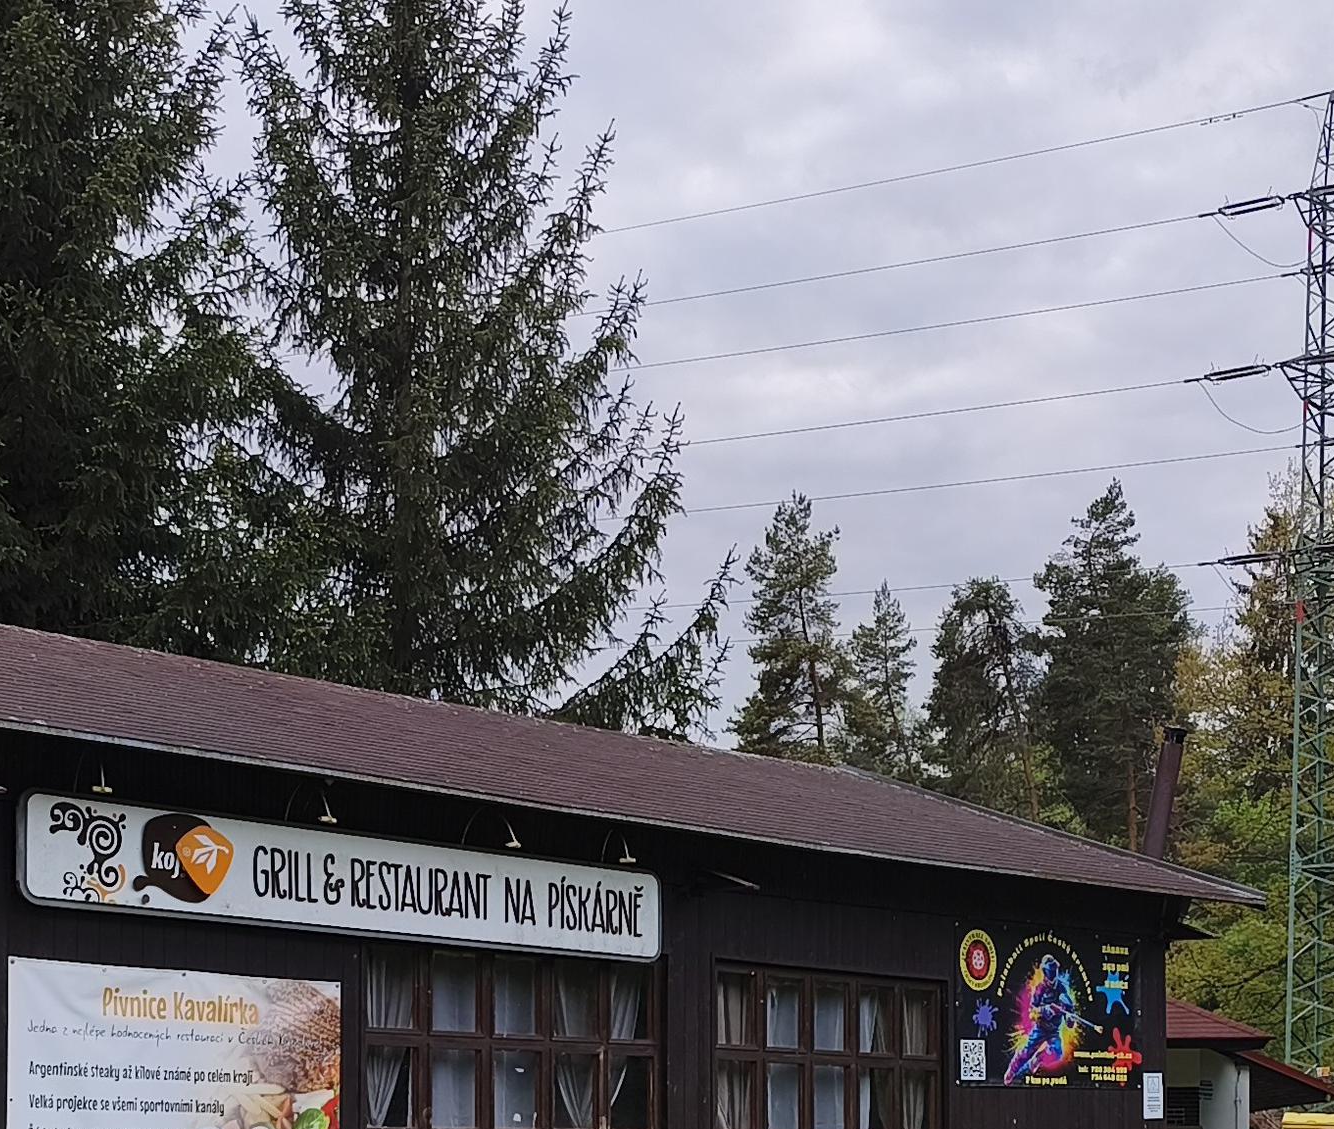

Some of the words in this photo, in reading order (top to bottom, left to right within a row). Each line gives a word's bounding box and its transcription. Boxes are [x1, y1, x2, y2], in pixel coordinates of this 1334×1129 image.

[253, 845, 319, 904] GRILL
[324, 852, 345, 906] &
[350, 859, 492, 921] RESTAURANT
[504, 878, 537, 926] NA
[548, 876, 644, 938] PÍSKÁRNĚ
[102, 986, 167, 1020] Pivnice
[173, 990, 260, 1025] Kavalírka
[72, 1021, 106, 1041] nejlépe
[111, 1023, 172, 1047] hodnocených
[29, 1060, 89, 1079] Argentinské
[90, 1063, 120, 1082] steaky
[122, 1064, 133, 1080] až
[163, 1066, 192, 1082] známé
[193, 1070, 206, 1084] po
[207, 1067, 232, 1083] celém
[233, 1069, 254, 1087] kraji
[29, 1093, 54, 1109] Velká
[56, 1094, 98, 1113] projekce
[100, 1099, 110, 1111] se
[112, 1096, 138, 1112] všemi
[139, 1098, 193, 1115] sportovními
[194, 1098, 225, 1117] kanály
